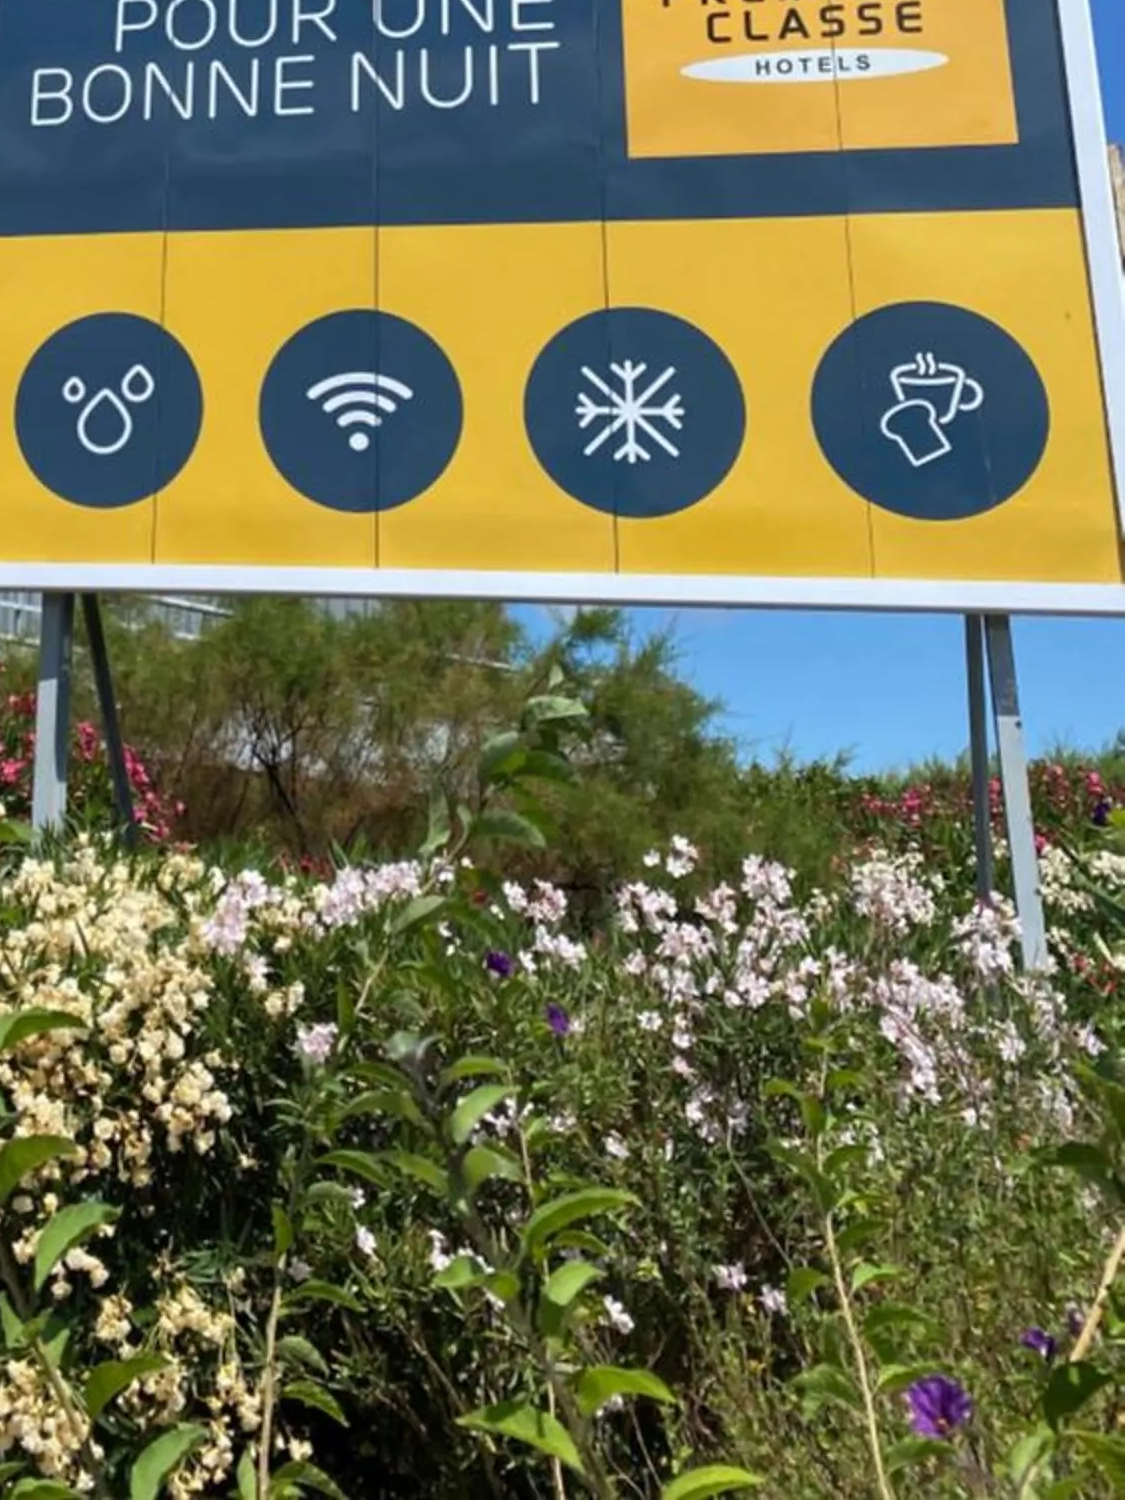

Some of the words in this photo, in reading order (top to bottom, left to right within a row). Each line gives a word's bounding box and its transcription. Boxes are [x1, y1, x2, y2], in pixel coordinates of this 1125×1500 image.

[706, 1, 923, 43] CLASSE
[30, 55, 315, 126] BONNE
[351, 42, 561, 112] NUIT
[755, 54, 871, 76] HOTELS
